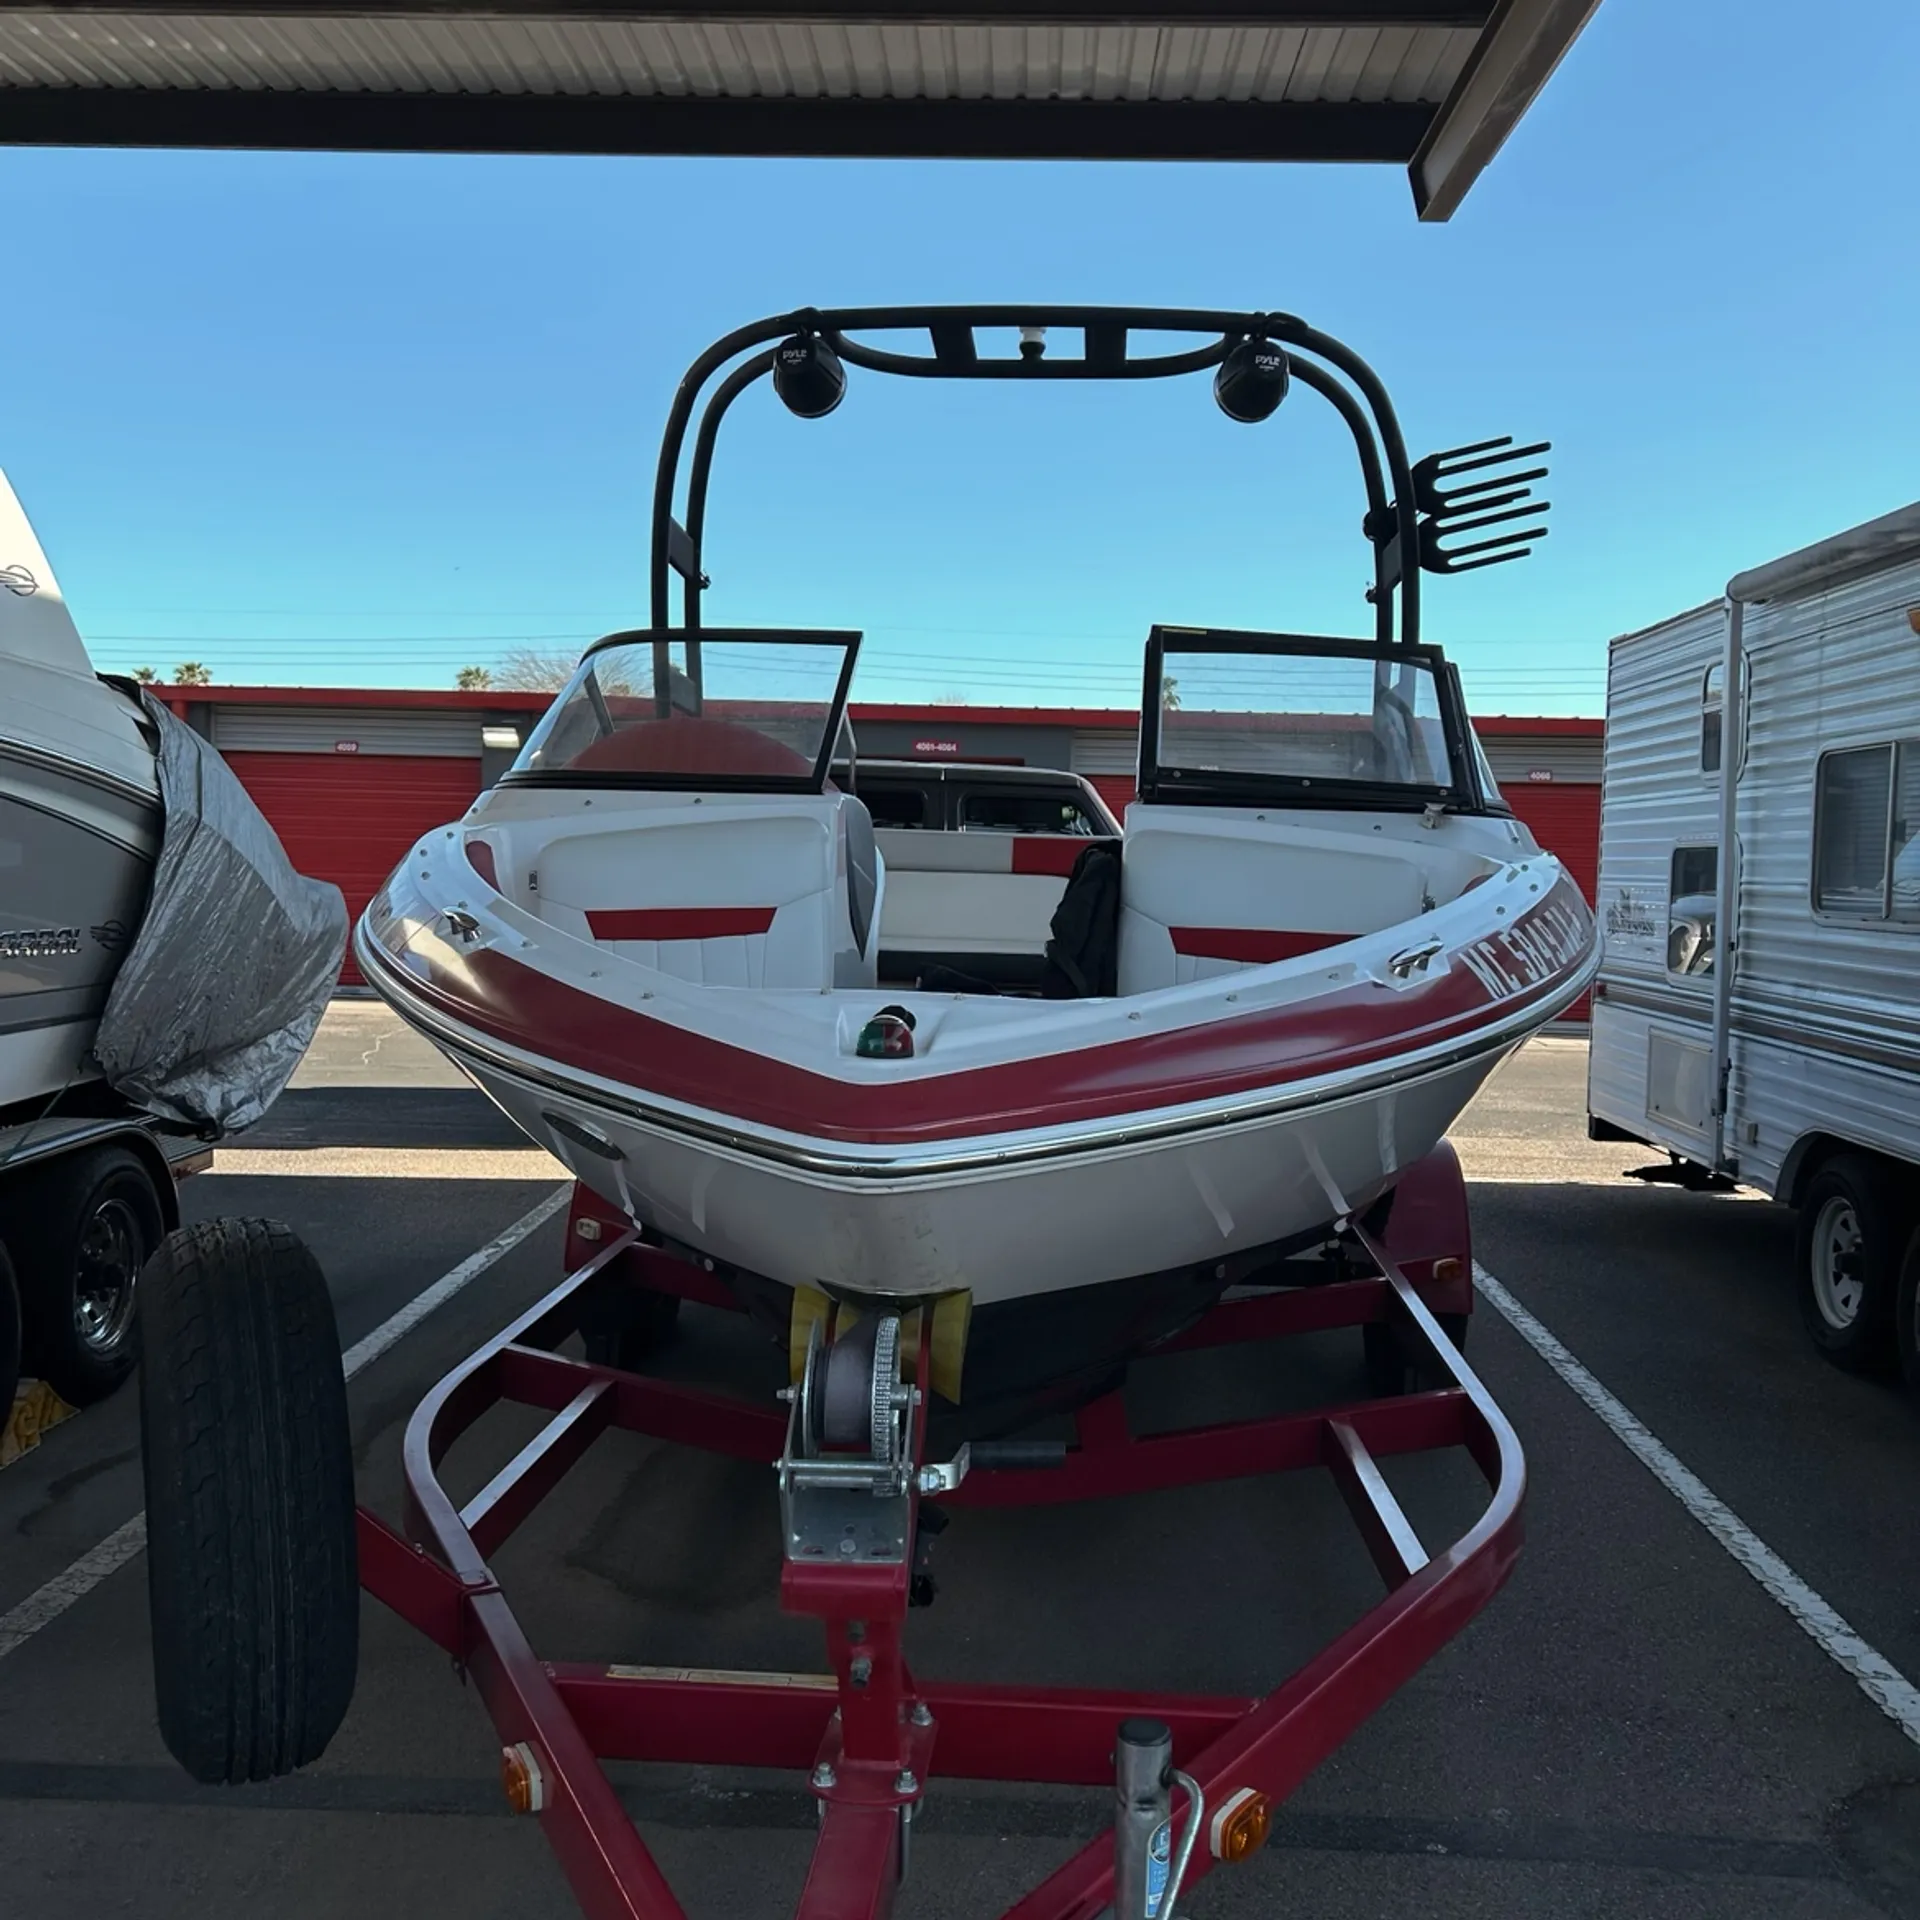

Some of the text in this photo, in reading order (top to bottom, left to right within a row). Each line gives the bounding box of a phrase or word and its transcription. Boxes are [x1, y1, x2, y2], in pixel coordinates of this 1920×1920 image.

[782, 349, 808, 360] PYLE
[1255, 354, 1281, 366] PYLE
[1458, 942, 1522, 999] MC
